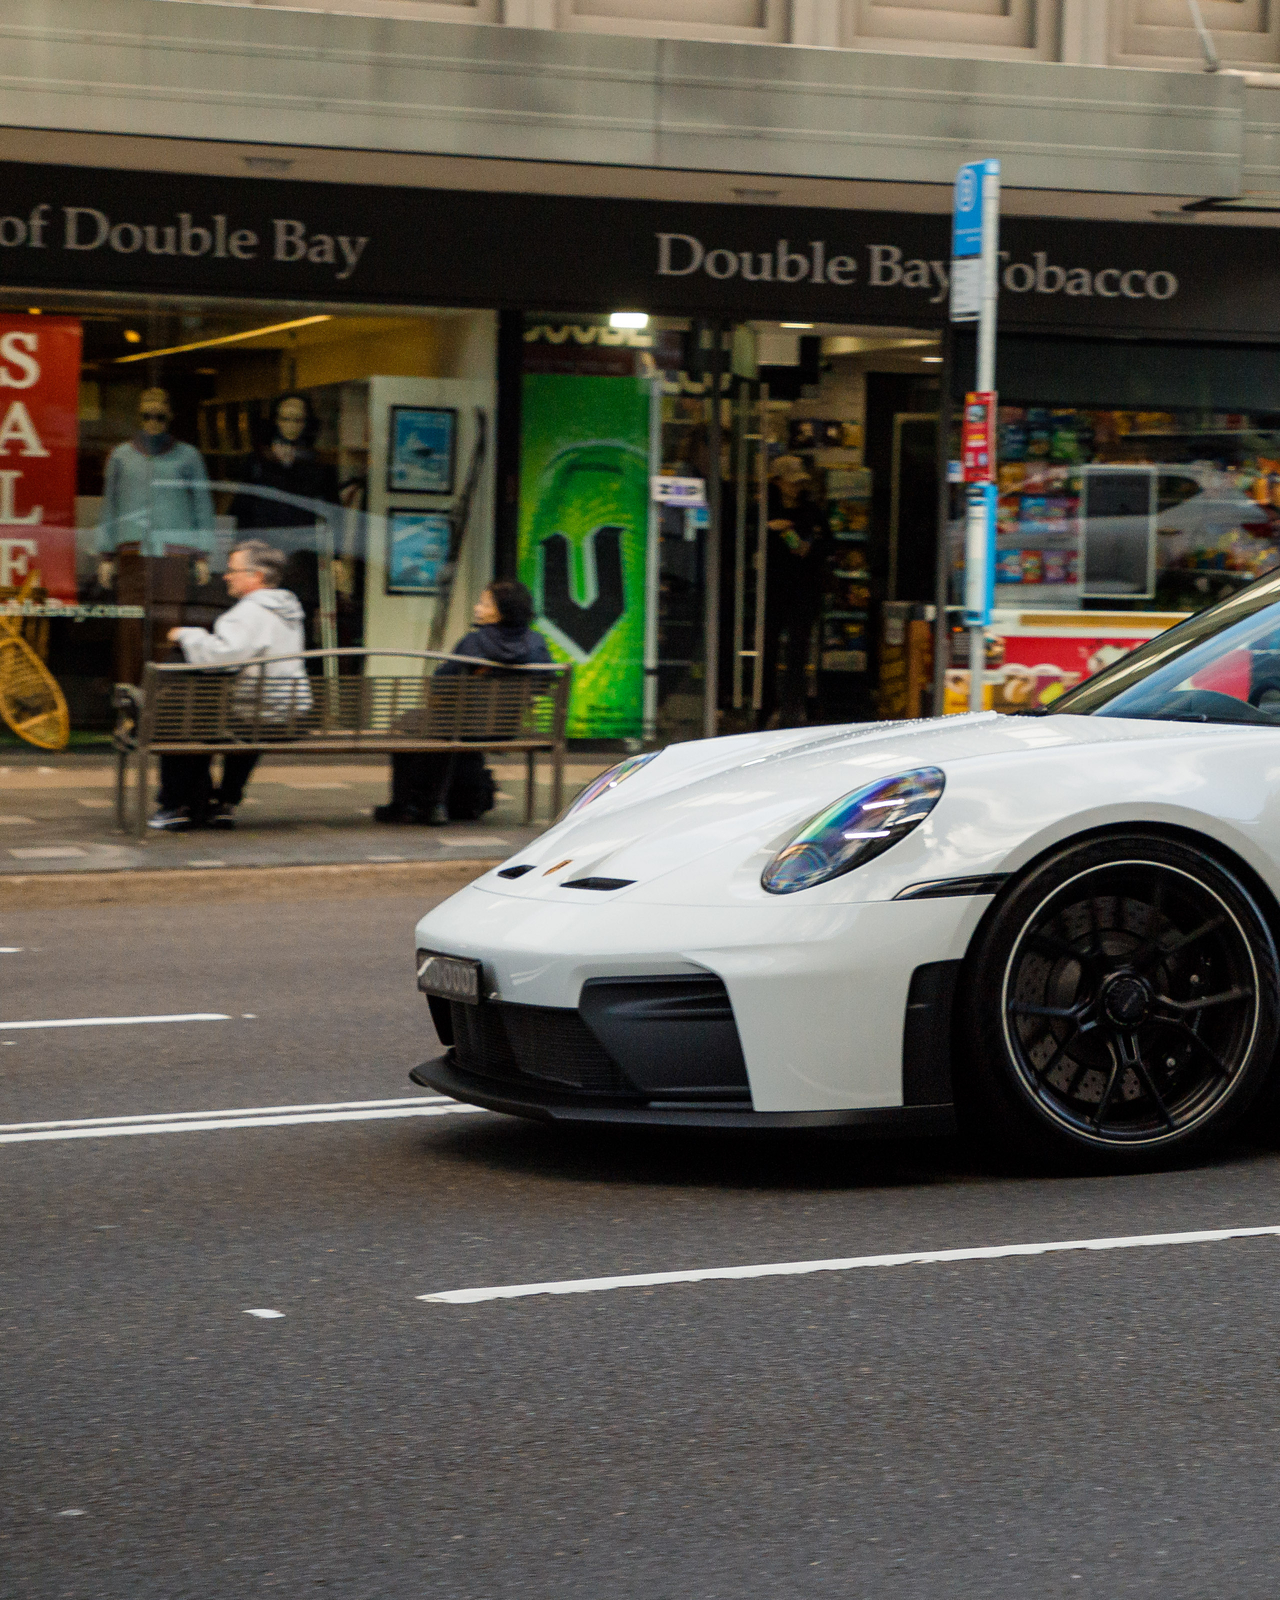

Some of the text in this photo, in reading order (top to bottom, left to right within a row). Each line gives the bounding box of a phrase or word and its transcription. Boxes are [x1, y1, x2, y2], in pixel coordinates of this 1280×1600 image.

[0, 203, 370, 280] of Double Bay
[656, 232, 858, 285] Double
[868, 244, 951, 302] Bay
[999, 251, 1179, 300] obacco
